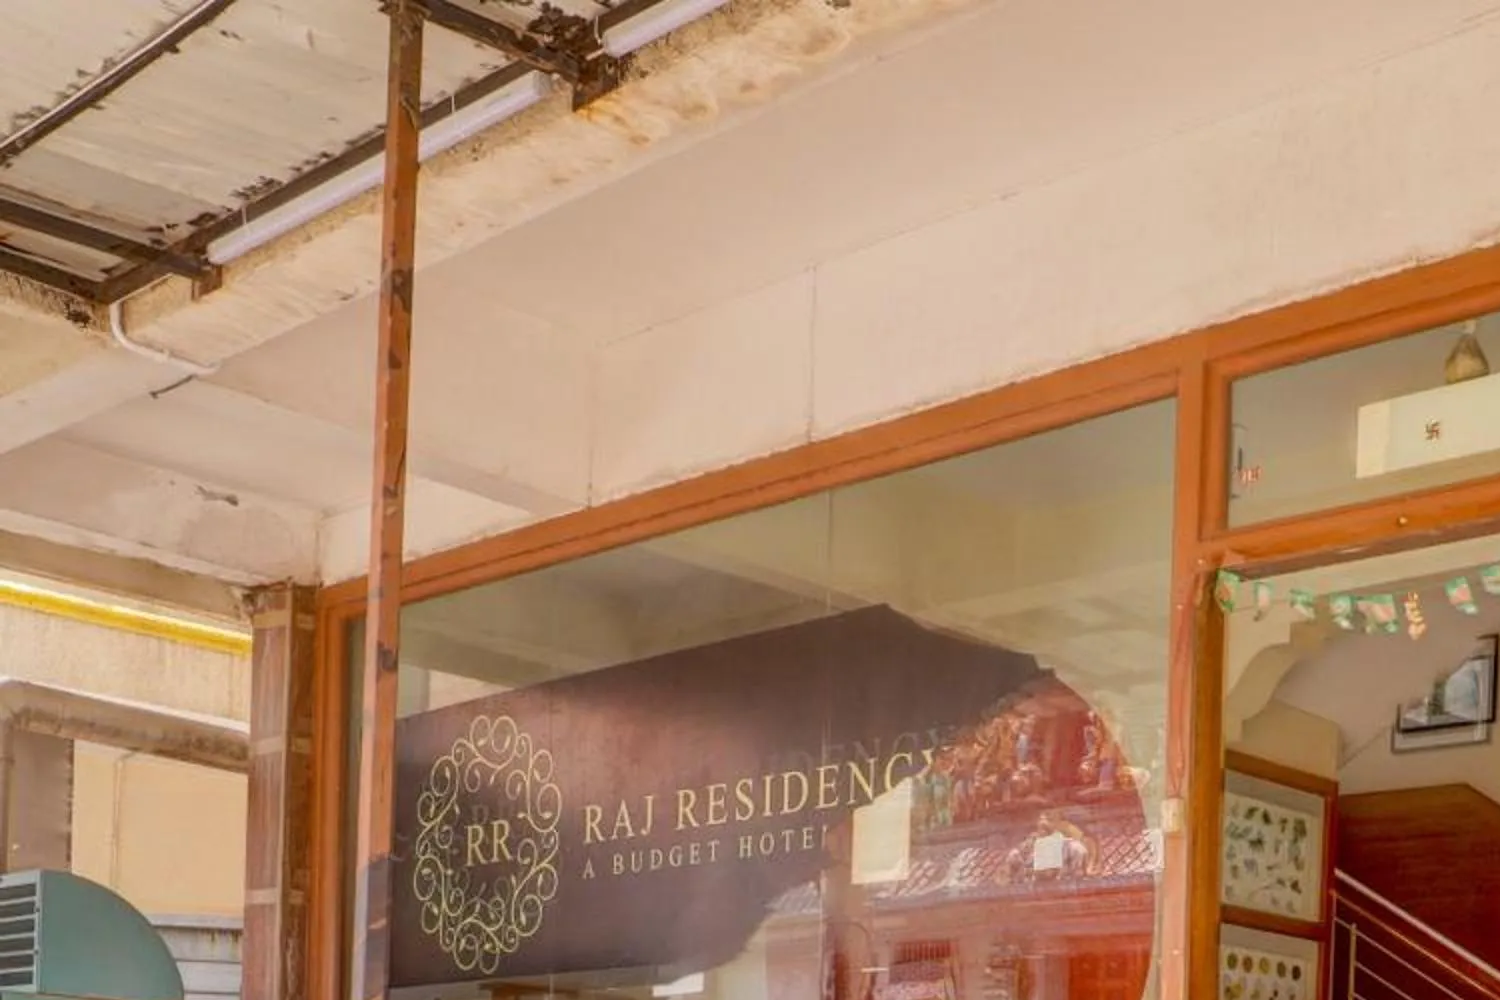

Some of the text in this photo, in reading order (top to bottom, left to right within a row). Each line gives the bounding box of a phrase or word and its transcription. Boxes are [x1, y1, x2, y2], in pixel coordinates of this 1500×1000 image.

[464, 819, 513, 868] RR
[582, 795, 656, 844] RAJ
[582, 857, 597, 880] A
[612, 838, 721, 876] BUDGET
